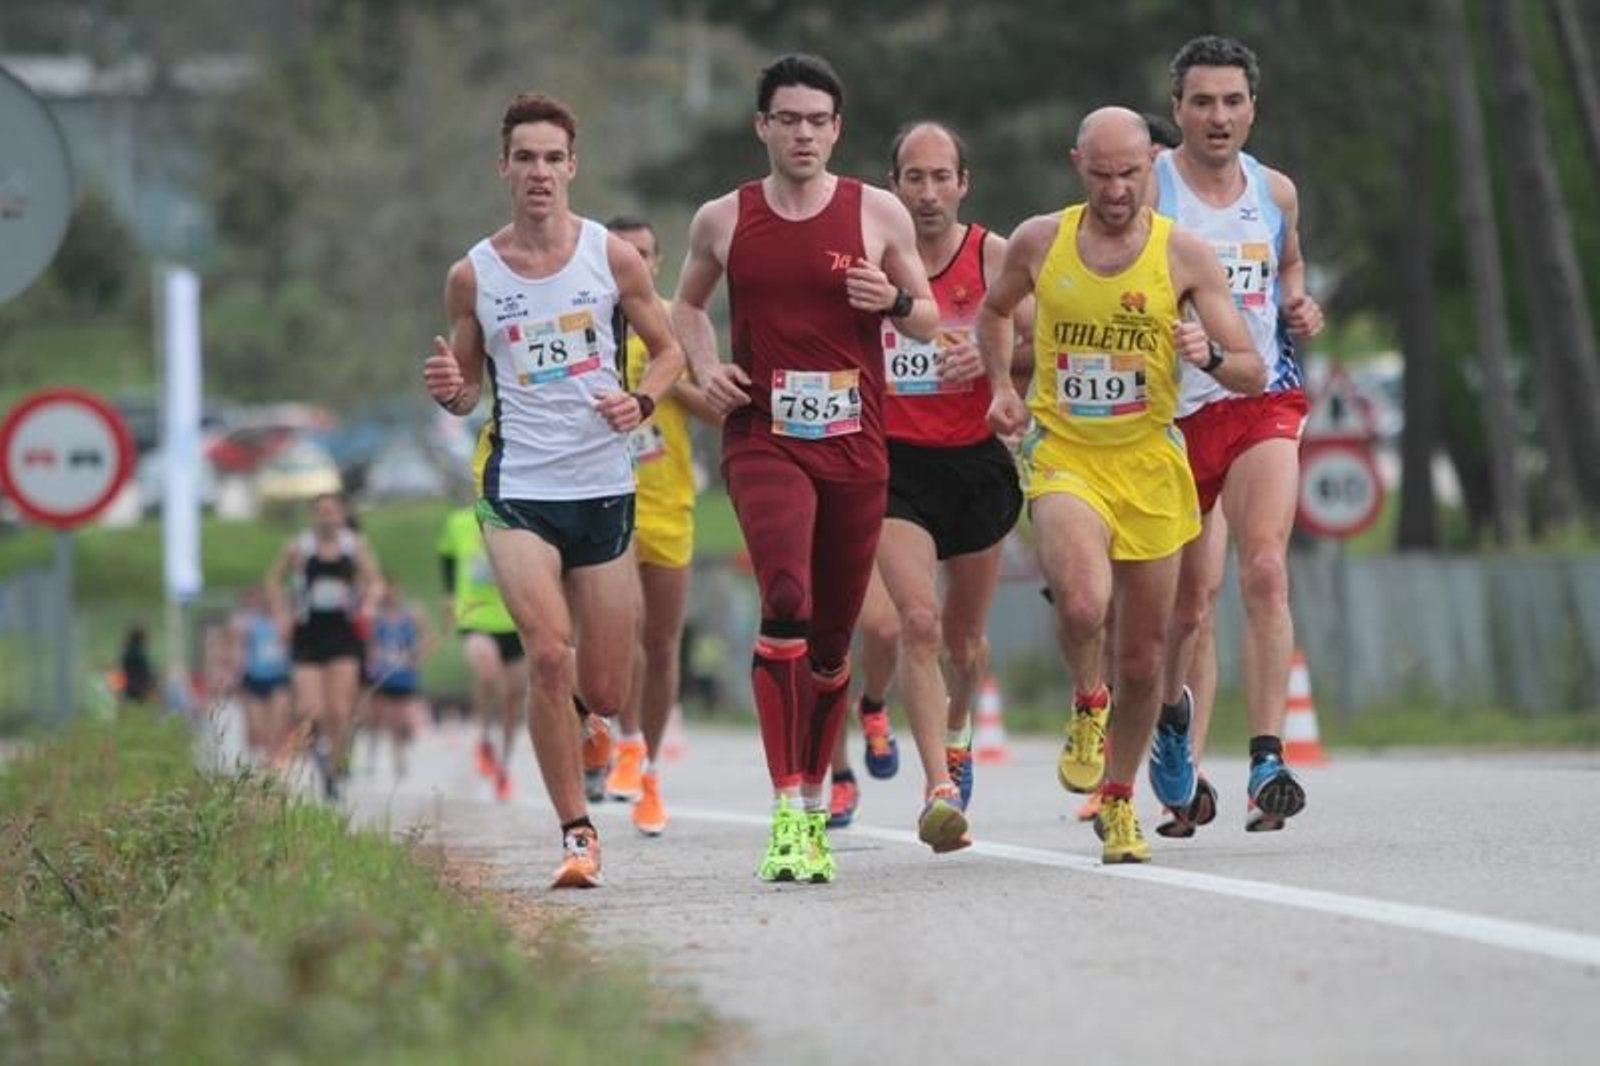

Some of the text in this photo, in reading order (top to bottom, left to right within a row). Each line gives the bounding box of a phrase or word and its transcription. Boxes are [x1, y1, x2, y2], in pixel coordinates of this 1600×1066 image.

[528, 339, 568, 366] 78
[892, 353, 938, 377] 69
[1064, 376, 1125, 400] 619
[779, 397, 841, 420] 785
